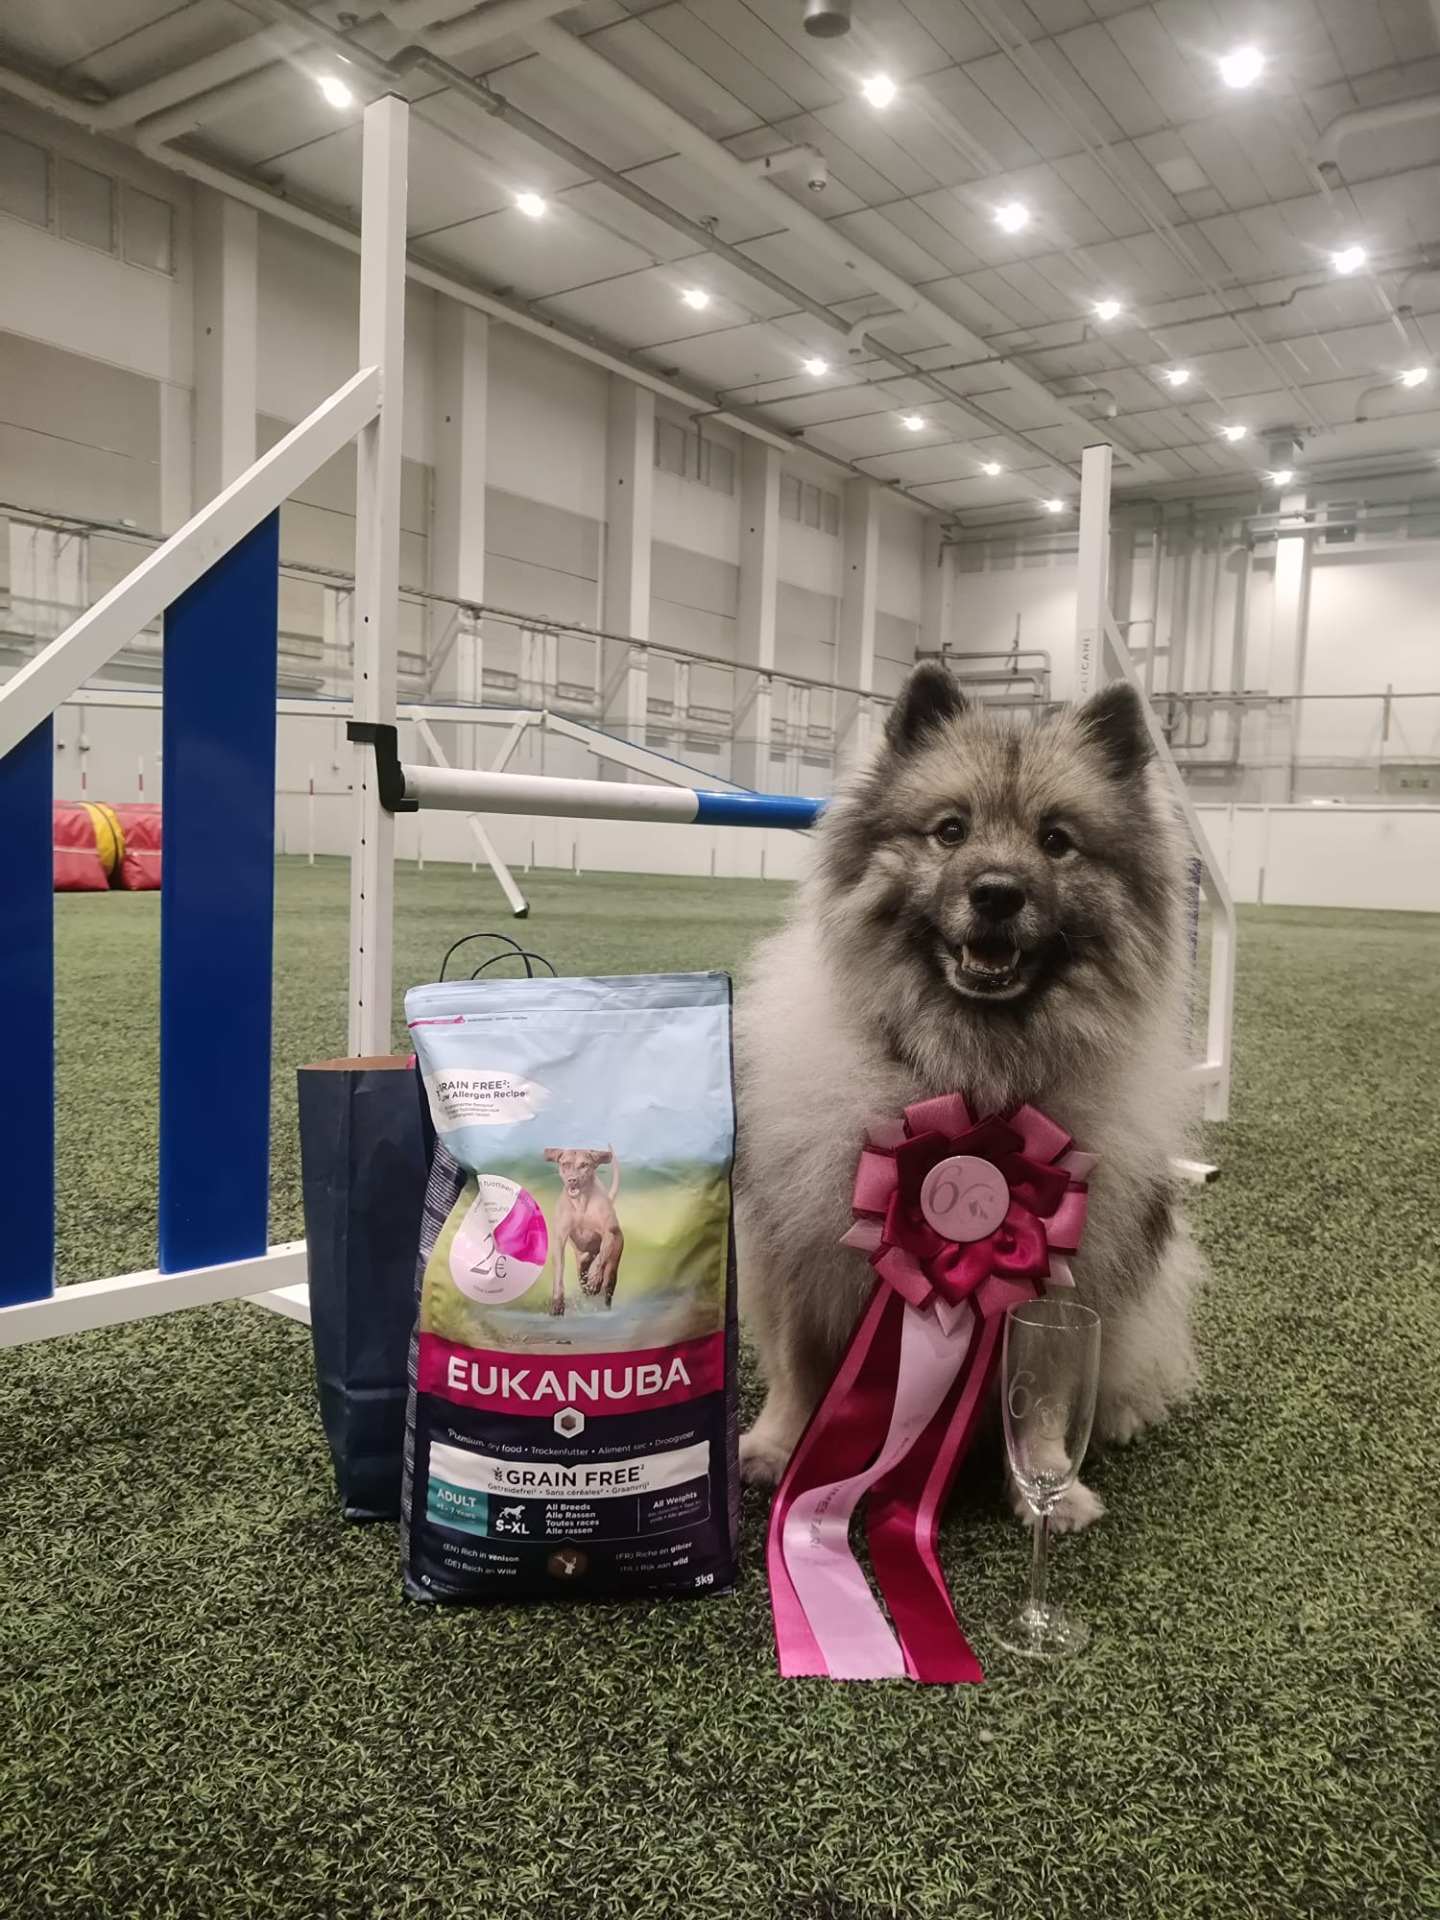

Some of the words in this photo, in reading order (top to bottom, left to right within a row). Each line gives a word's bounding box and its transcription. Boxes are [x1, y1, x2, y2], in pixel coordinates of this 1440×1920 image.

[452, 1091, 491, 1100] Allergen
[446, 1355, 692, 1403] EUKANUBA
[447, 1427, 485, 1447] Premium
[501, 1443, 522, 1453] food
[531, 1446, 589, 1456] Trockenfutter
[597, 1444, 631, 1455] Aliment
[633, 1442, 647, 1451] sec
[654, 1430, 695, 1447] Droogvoer
[506, 1470, 577, 1487] GRAIN
[437, 1488, 477, 1508] ADULT
[545, 1488, 565, 1496] Sans
[545, 1503, 557, 1511] All
[560, 1503, 591, 1511] Breeds
[653, 1499, 665, 1510] All
[666, 1491, 698, 1506] Weights
[456, 1508, 476, 1519] Years
[545, 1511, 563, 1519] Alle
[565, 1511, 596, 1519] Rassen
[495, 1519, 530, 1535] S-XL
[545, 1519, 574, 1527] Toutes
[576, 1519, 599, 1527] races
[545, 1527, 563, 1535] Alle
[565, 1527, 593, 1535] rassen
[442, 1542, 459, 1554] (EN)
[461, 1547, 478, 1558] Rich
[488, 1554, 520, 1562] venison
[635, 1550, 658, 1558] Riche
[670, 1541, 693, 1554] gibier
[672, 1556, 689, 1567] wild
[462, 1563, 483, 1573] Reich
[497, 1567, 517, 1575] Wild
[694, 1572, 714, 1588] 3kg
